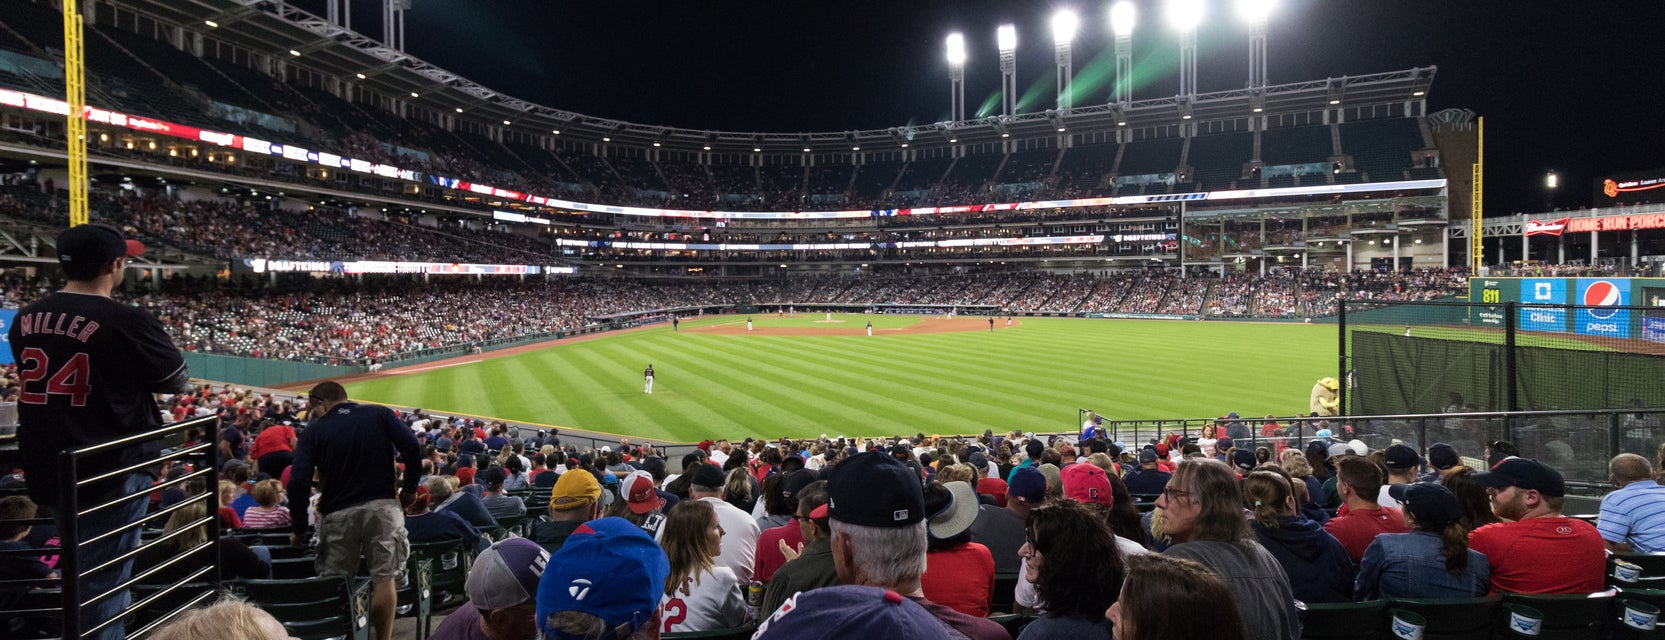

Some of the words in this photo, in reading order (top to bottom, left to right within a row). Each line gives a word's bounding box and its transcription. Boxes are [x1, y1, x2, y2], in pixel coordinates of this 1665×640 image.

[1570, 218, 1601, 232] HOME
[1602, 216, 1627, 231] RUN
[1629, 214, 1665, 229] PORC
[268, 261, 331, 272] DRAFTKINGS
[1483, 289, 1500, 304] 811
[1530, 312, 1556, 323] Clinic
[21, 312, 100, 343] MILLER
[1587, 323, 1618, 334] pepsi
[20, 347, 92, 407] 24
